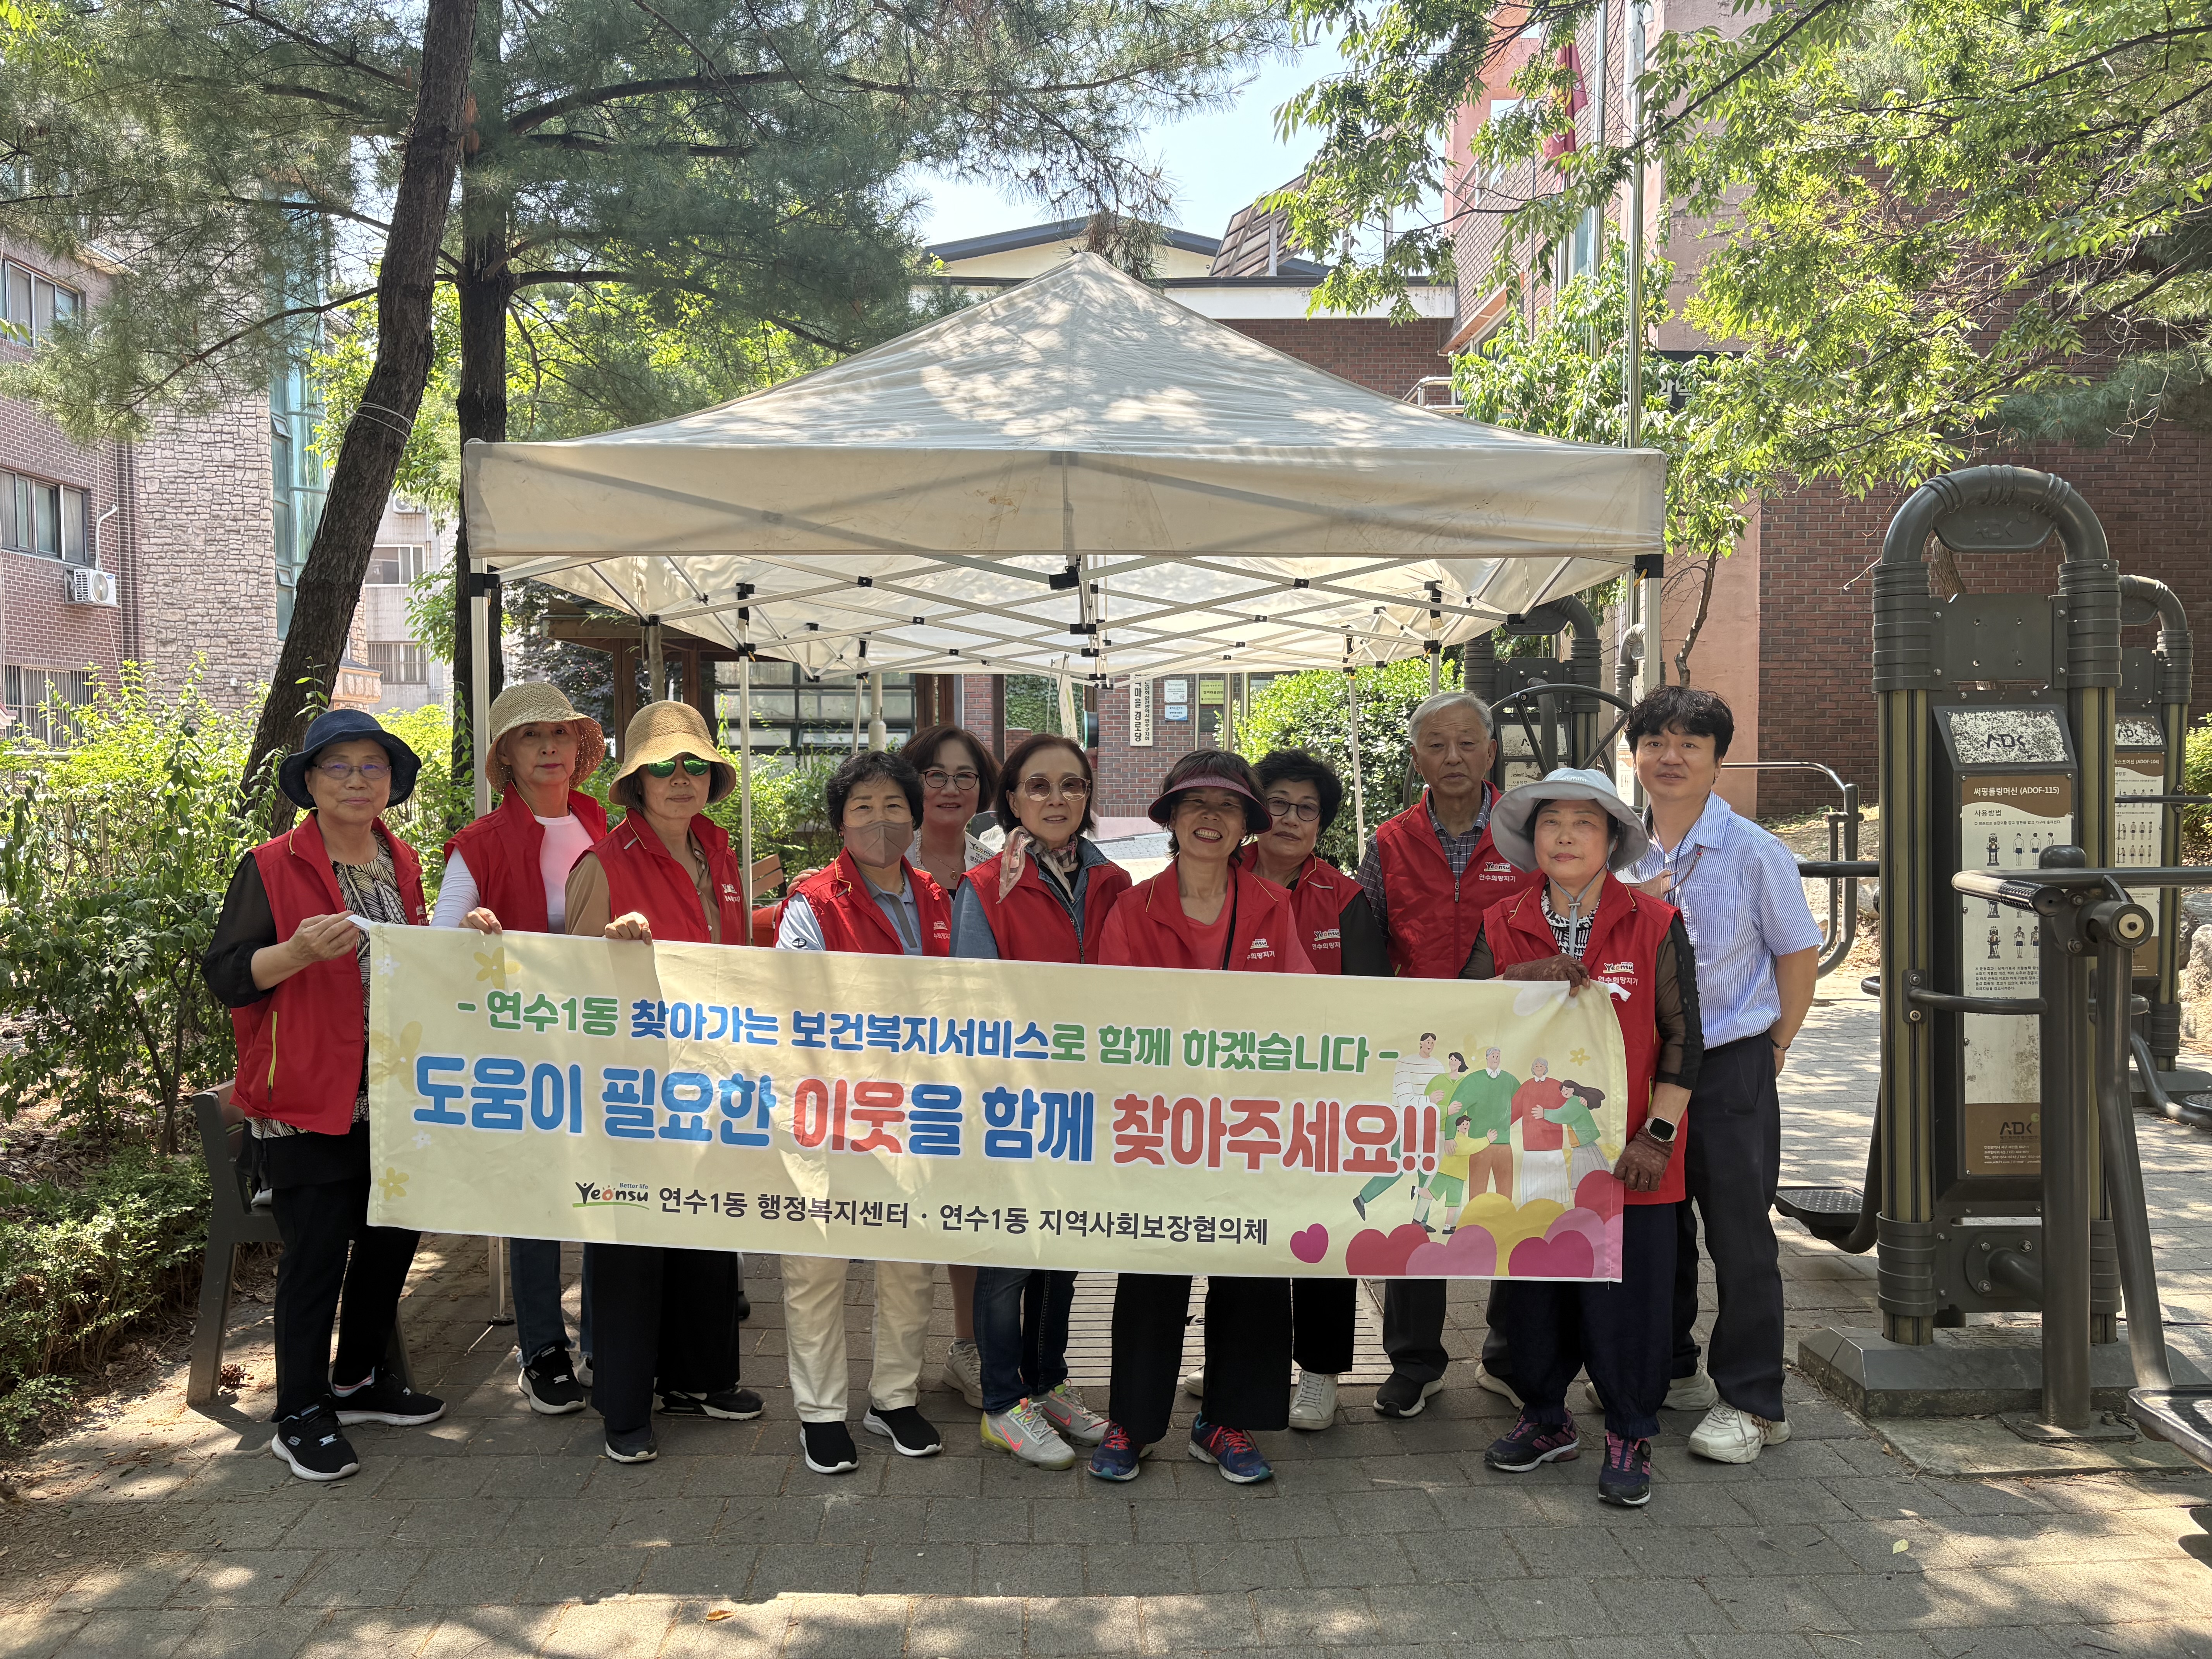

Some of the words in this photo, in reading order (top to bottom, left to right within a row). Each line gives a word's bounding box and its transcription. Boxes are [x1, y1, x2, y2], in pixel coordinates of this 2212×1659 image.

[1974, 787, 2017, 796] 써핑롤링머신
[2020, 787, 2060, 795] (ADOF-115)
[1479, 874, 1516, 882] 연수희망지기
[1314, 930, 1339, 939] Yeonsu
[1605, 963, 1633, 972] Yeonsu
[1598, 976, 1638, 986] 연수희망지기
[488, 991, 618, 1036] 연수1동
[632, 1000, 779, 1045] 찾아가는
[792, 1011, 1085, 1061] 보건복지서비스로
[1099, 1026, 1171, 1066] 함께
[1183, 1030, 1369, 1073] 하겠습니다
[414, 1056, 582, 1133] 도움이
[602, 1068, 777, 1147] 필요한
[793, 1079, 963, 1156] 이웃을
[982, 1087, 1094, 1162] 함께
[1113, 1094, 1436, 1173] 찾아주세요!!
[575, 1182, 648, 1204] Yeonsu
[659, 1188, 748, 1218] 연수1동
[757, 1194, 908, 1228] 행정복지센터
[940, 1205, 1029, 1234] 연수1동
[1038, 1209, 1267, 1245] 지역사회보장협의체
